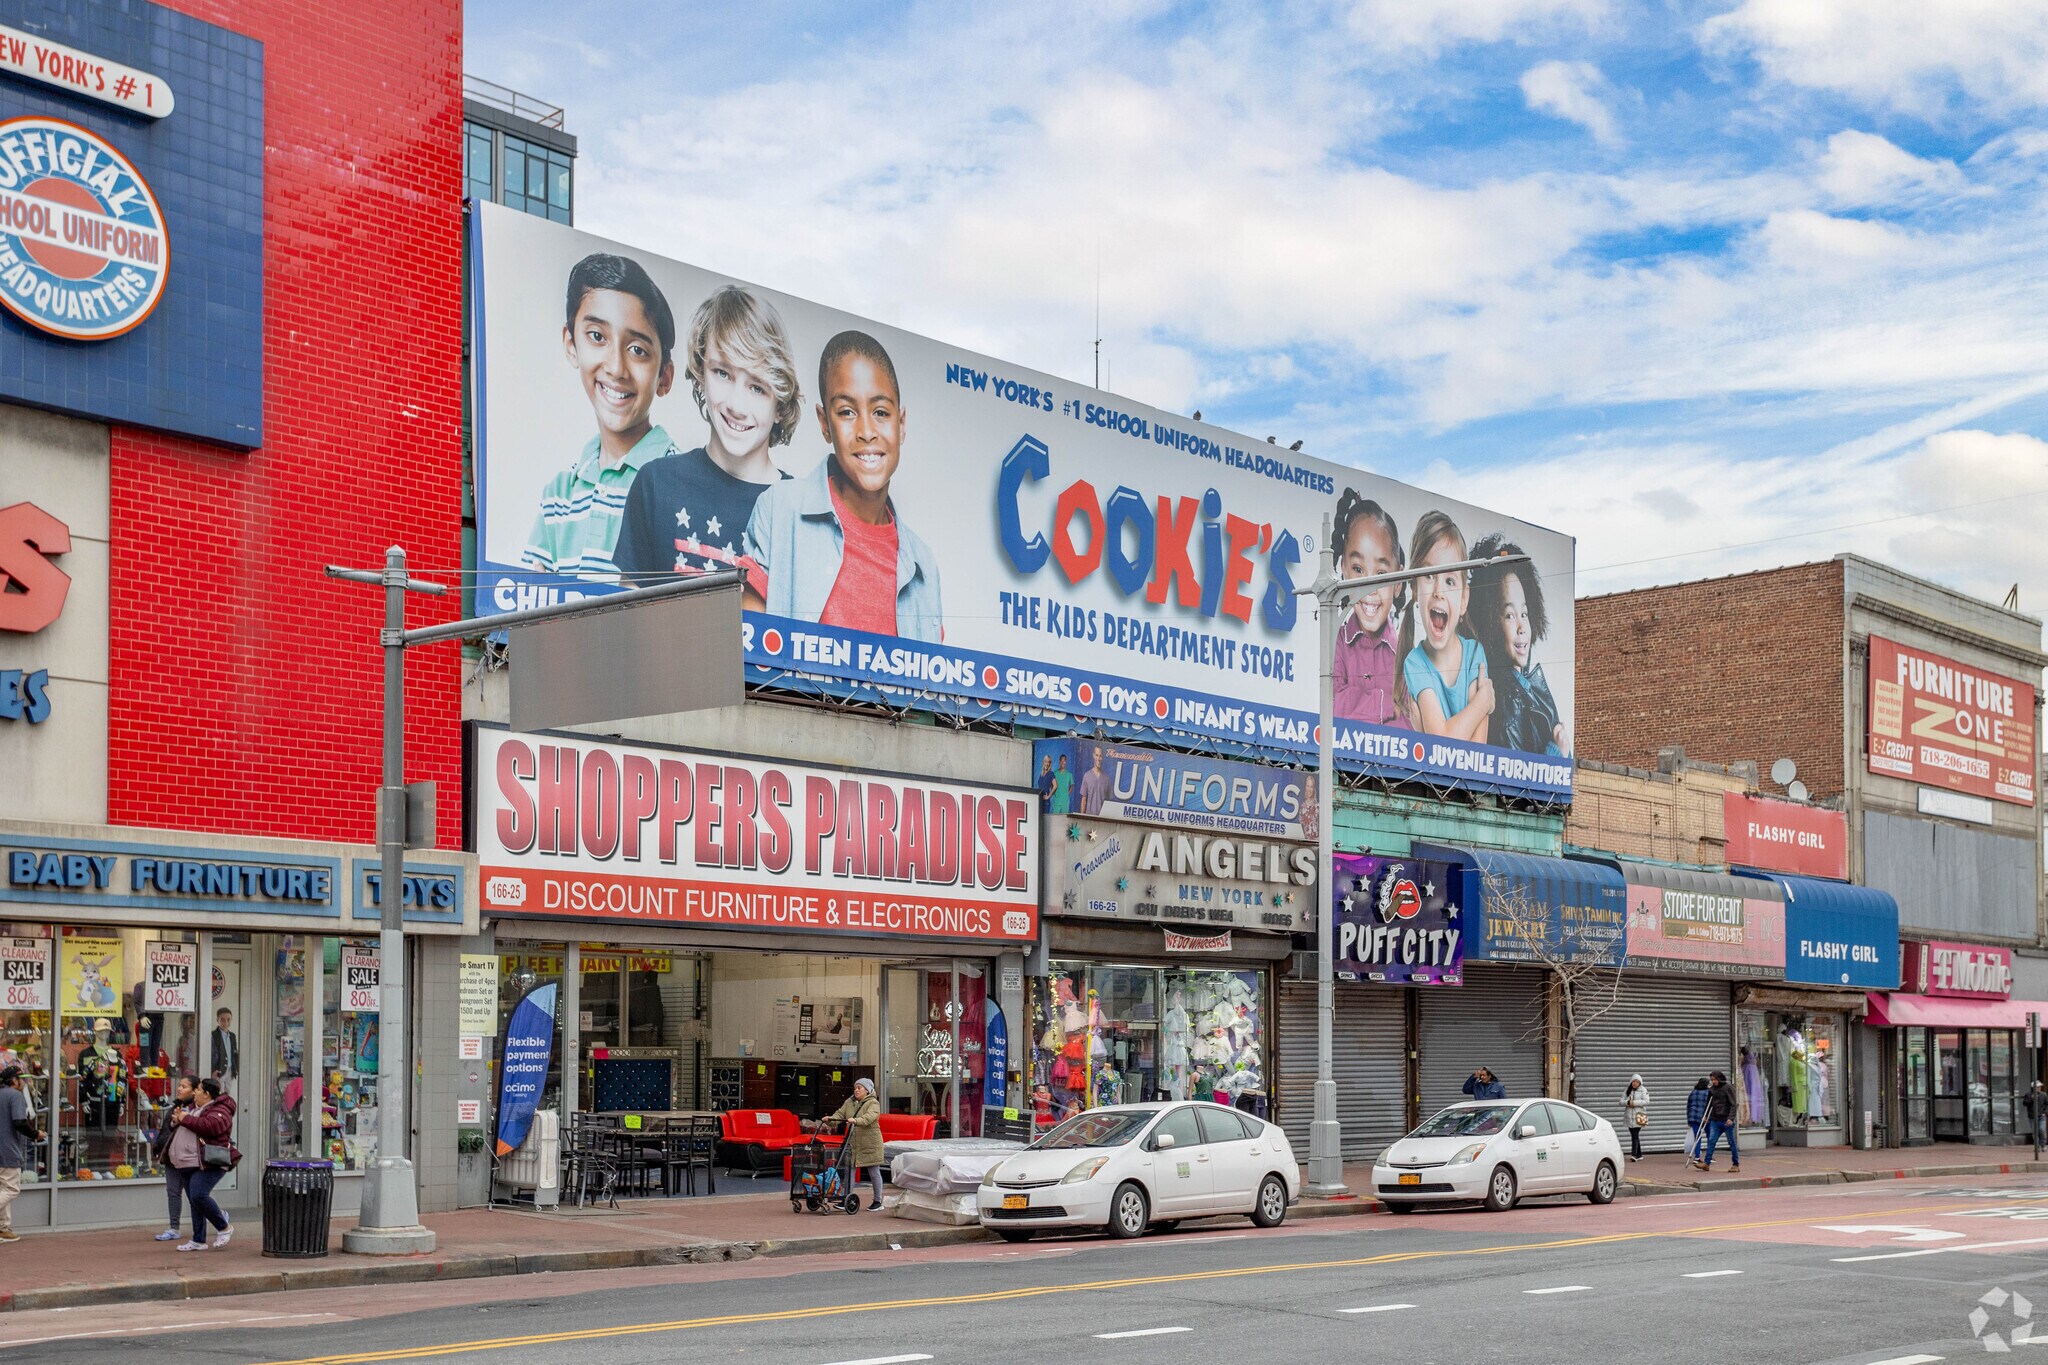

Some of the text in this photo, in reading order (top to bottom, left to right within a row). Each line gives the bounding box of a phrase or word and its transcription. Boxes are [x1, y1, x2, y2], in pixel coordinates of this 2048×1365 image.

[0, 34, 26, 67] EW
[34, 45, 105, 92] YORK'S
[62, 211, 159, 265] UNIFORM
[946, 362, 1335, 496] NEW YORK'S #1 SCHOOL UNIFORM HEADQUARTERS
[1000, 591, 1295, 683] THE KIDS DEPARTMENT STORE
[1896, 652, 2014, 718] FURNITURE
[790, 631, 852, 665] TEEN
[857, 643, 977, 688] FASHIONS
[1005, 668, 1073, 703] SHOES
[1098, 685, 1149, 716] TOYS
[1173, 698, 1256, 737] INFANT'S
[1258, 714, 1309, 744] WEAR
[1331, 725, 1409, 761] LAYETTES
[1428, 743, 1495, 775] JUVENILE
[1497, 756, 1572, 787] FURNITURE
[1911, 697, 2006, 758] ZONE
[1873, 737, 1914, 762] E-Z CREDIT
[1921, 748, 1990, 778] 718-206-1655
[1112, 760, 1301, 821] UNIFORMS
[1998, 767, 2033, 790] E-Z CREDIT
[495, 738, 1030, 893] SHOPPERS PARADISE
[1122, 805, 1287, 836] MEDICAL UNIFORMS HEADQUARTERS
[1748, 822, 1826, 850] FLASHY GIRL
[1073, 837, 1122, 882] Treasurable
[1136, 831, 1318, 887] ANGELS
[9, 850, 330, 901] BABY FURNITURE
[491, 880, 522, 902] 166-25
[1178, 884, 1264, 907] NEW YORK
[543, 878, 992, 935] DISCOUNT FURNITURE & ELECTRONICS
[1089, 899, 1117, 913] 166-25
[1663, 890, 1742, 925] STORE FOR RENT
[1006, 912, 1029, 932] 166-25
[1, 946, 48, 962] CLEARANCE
[1339, 921, 1401, 965] PUFF
[1800, 939, 1850, 961] FLASHY
[1851, 943, 1879, 964] GIRL
[8, 961, 41, 980] SALE
[150, 951, 193, 966] CLEARANCE
[467, 960, 486, 970] Smart
[486, 961, 495, 970] TV
[156, 965, 187, 983] SALE
[350, 968, 378, 985] SALE
[484, 977, 496, 987] 4pcs
[460, 986, 478, 995] edroom
[478, 987, 487, 995] Set
[484, 997, 493, 1005] Set
[483, 1008, 491, 1016] Up
[507, 1037, 546, 1047] Flexible
[505, 1062, 544, 1075] options
[506, 1050, 549, 1062] payment
[504, 1082, 536, 1093] acima
